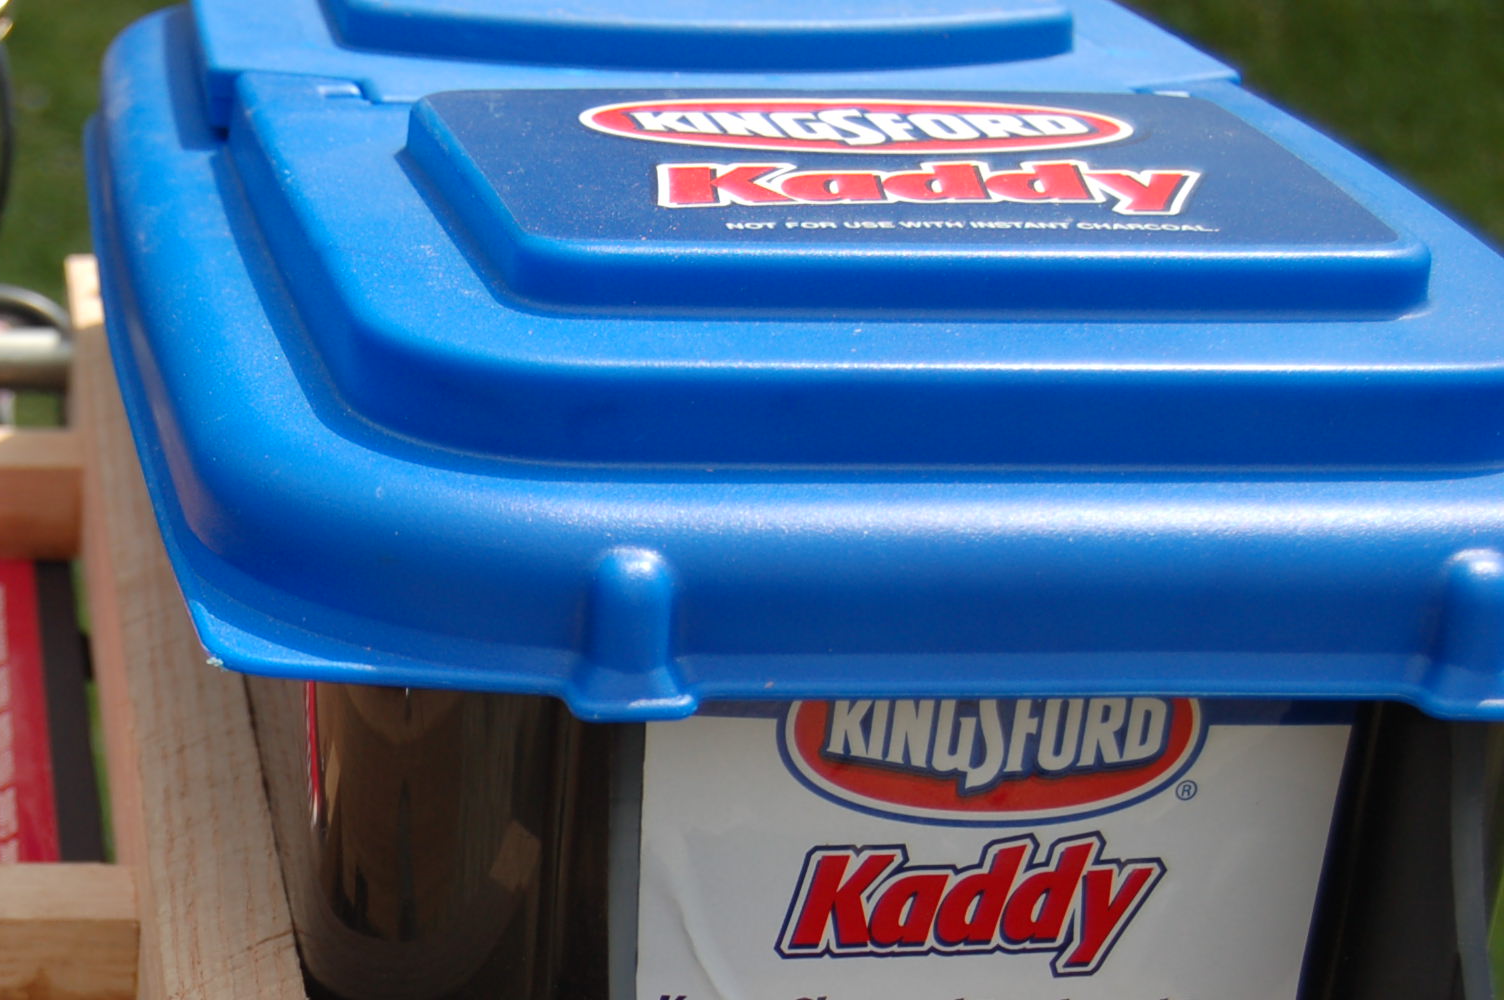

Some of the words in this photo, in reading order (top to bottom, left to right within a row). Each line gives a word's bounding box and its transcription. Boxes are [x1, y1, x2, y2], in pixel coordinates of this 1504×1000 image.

[632, 108, 1093, 146] KINGSFORD
[658, 162, 1198, 215] Kaddy
[725, 221, 776, 229] NOT
[785, 220, 837, 228] FOR
[843, 220, 895, 228] USE
[898, 220, 965, 228] WITH
[969, 219, 1073, 228] INSTANT
[1076, 221, 1219, 231] CHARCOAL.
[827, 698, 1168, 790] KINGSFORD
[776, 832, 1166, 977] Kaddy
